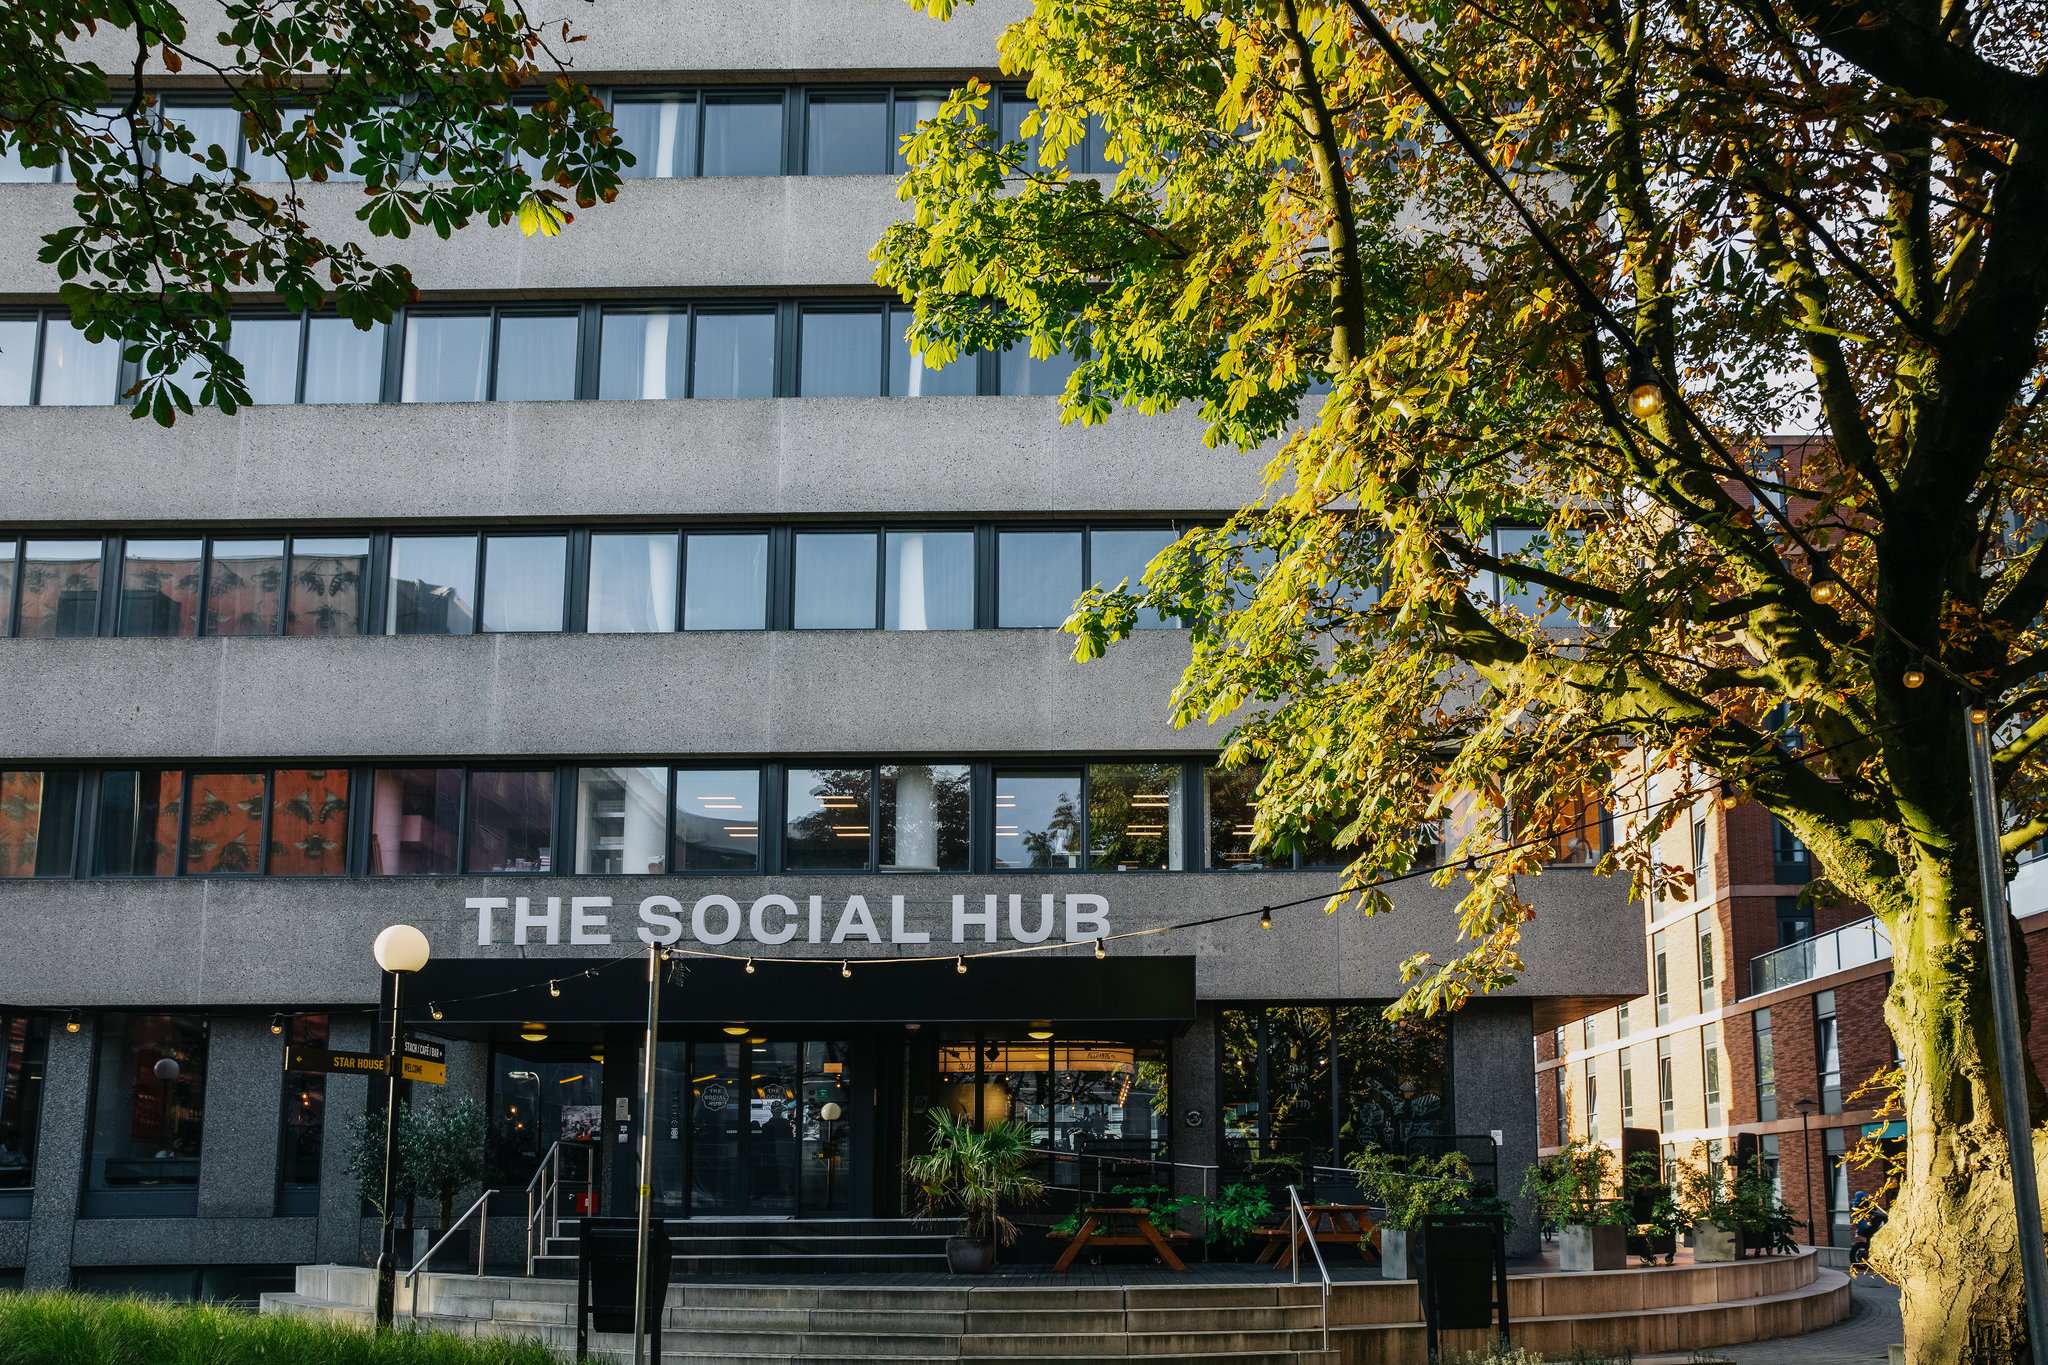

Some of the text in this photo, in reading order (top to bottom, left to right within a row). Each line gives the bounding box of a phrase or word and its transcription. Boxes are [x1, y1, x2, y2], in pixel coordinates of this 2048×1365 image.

[465, 893, 1110, 946] THE SOCIAL HUB
[431, 1047, 439, 1058] BAR
[333, 1056, 384, 1070] STAR HOUSE
[404, 1062, 423, 1075] WELCOME
